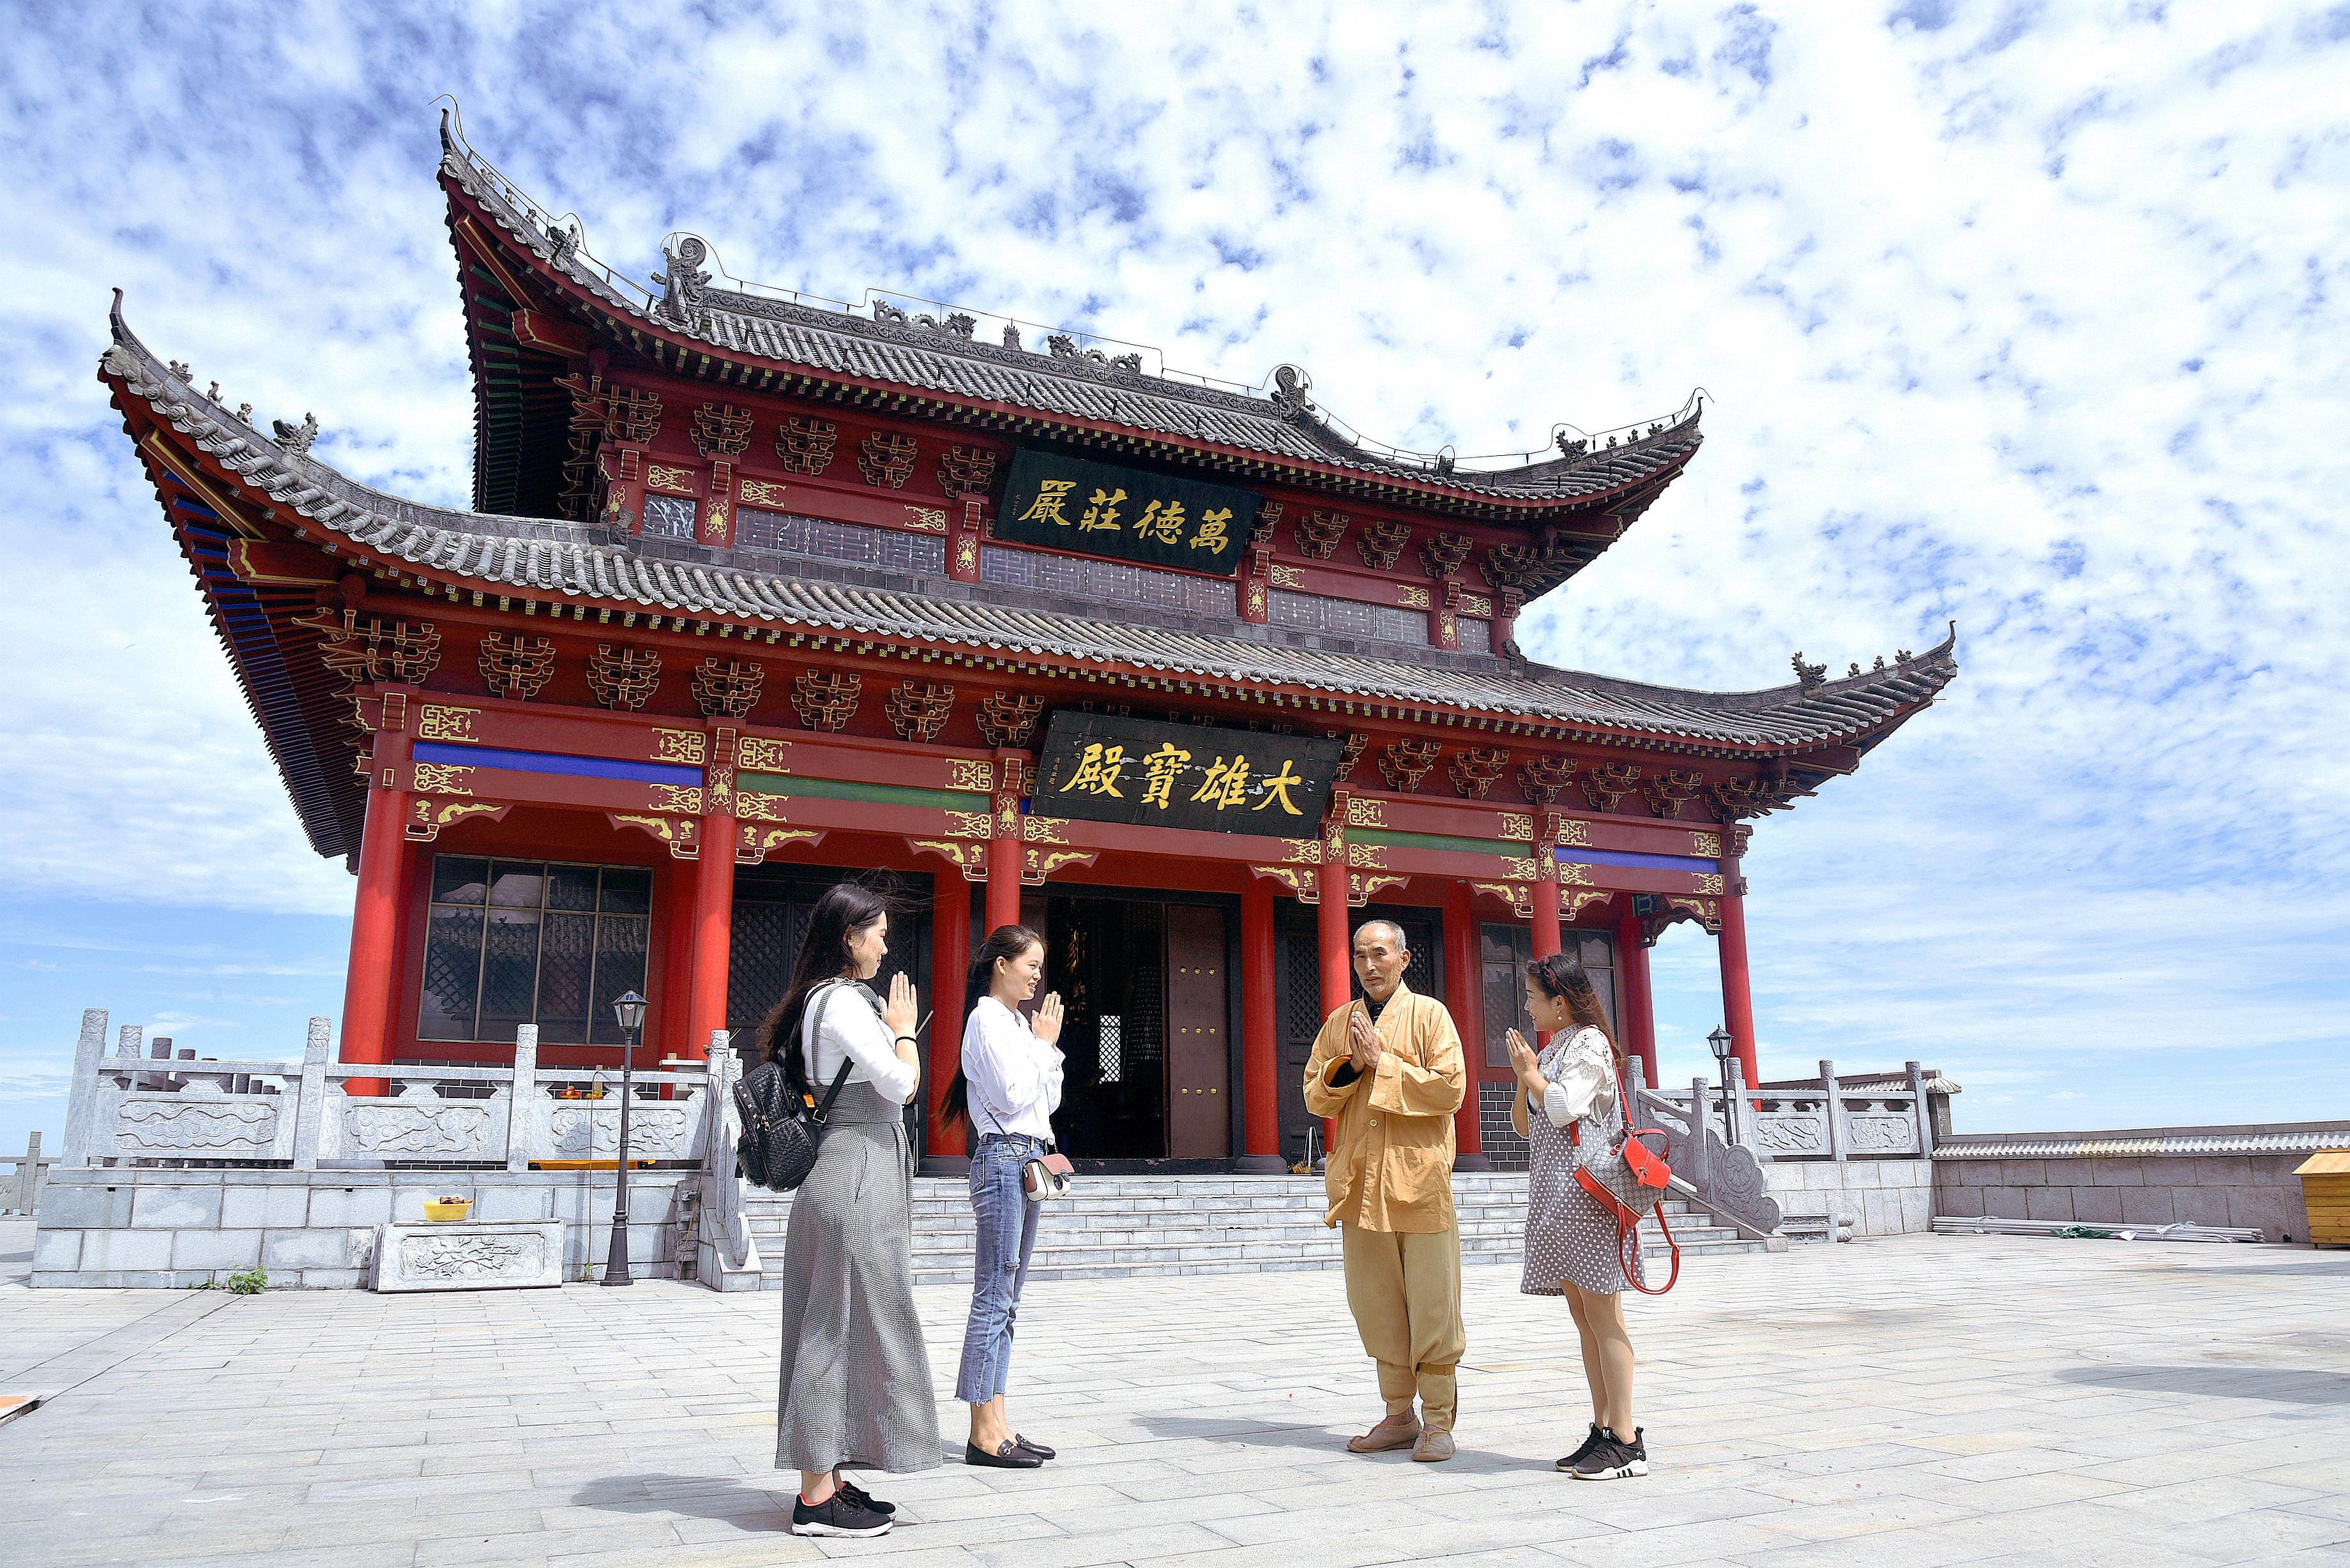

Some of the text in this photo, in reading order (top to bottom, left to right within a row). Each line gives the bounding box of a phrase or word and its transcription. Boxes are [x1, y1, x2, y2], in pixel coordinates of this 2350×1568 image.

[1058, 742, 1304, 816] 大雄寶殿
[1602, 1429, 1611, 1439] M
